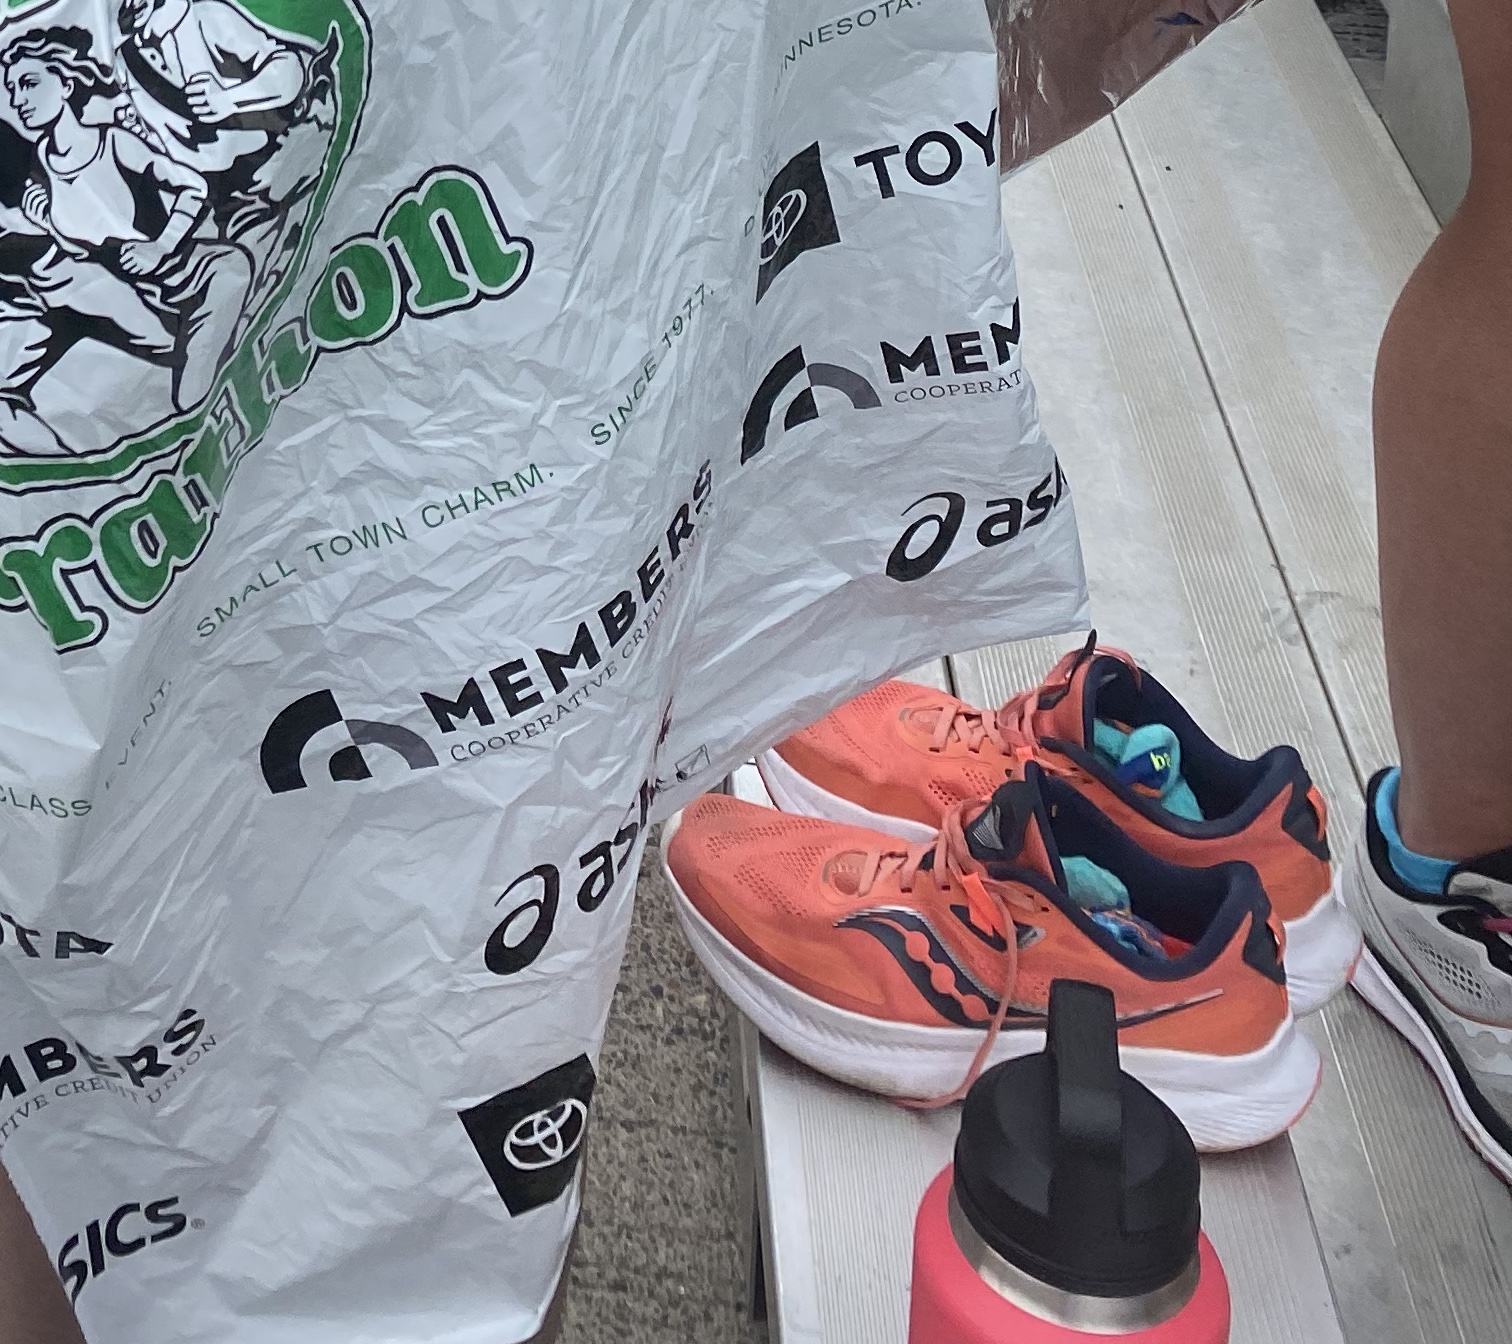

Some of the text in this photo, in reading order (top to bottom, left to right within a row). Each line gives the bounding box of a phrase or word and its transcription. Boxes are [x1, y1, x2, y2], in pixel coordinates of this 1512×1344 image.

[853, 108, 998, 200] TOY
[894, 369, 1022, 404] COOPERAT
[196, 557, 297, 639] SMALL
[306, 516, 409, 564] TOWN
[421, 462, 555, 529] CHARM.
[589, 350, 658, 447] SINCE
[419, 458, 713, 734] MEMBERS
[450, 660, 618, 763] COOPERATIVE
